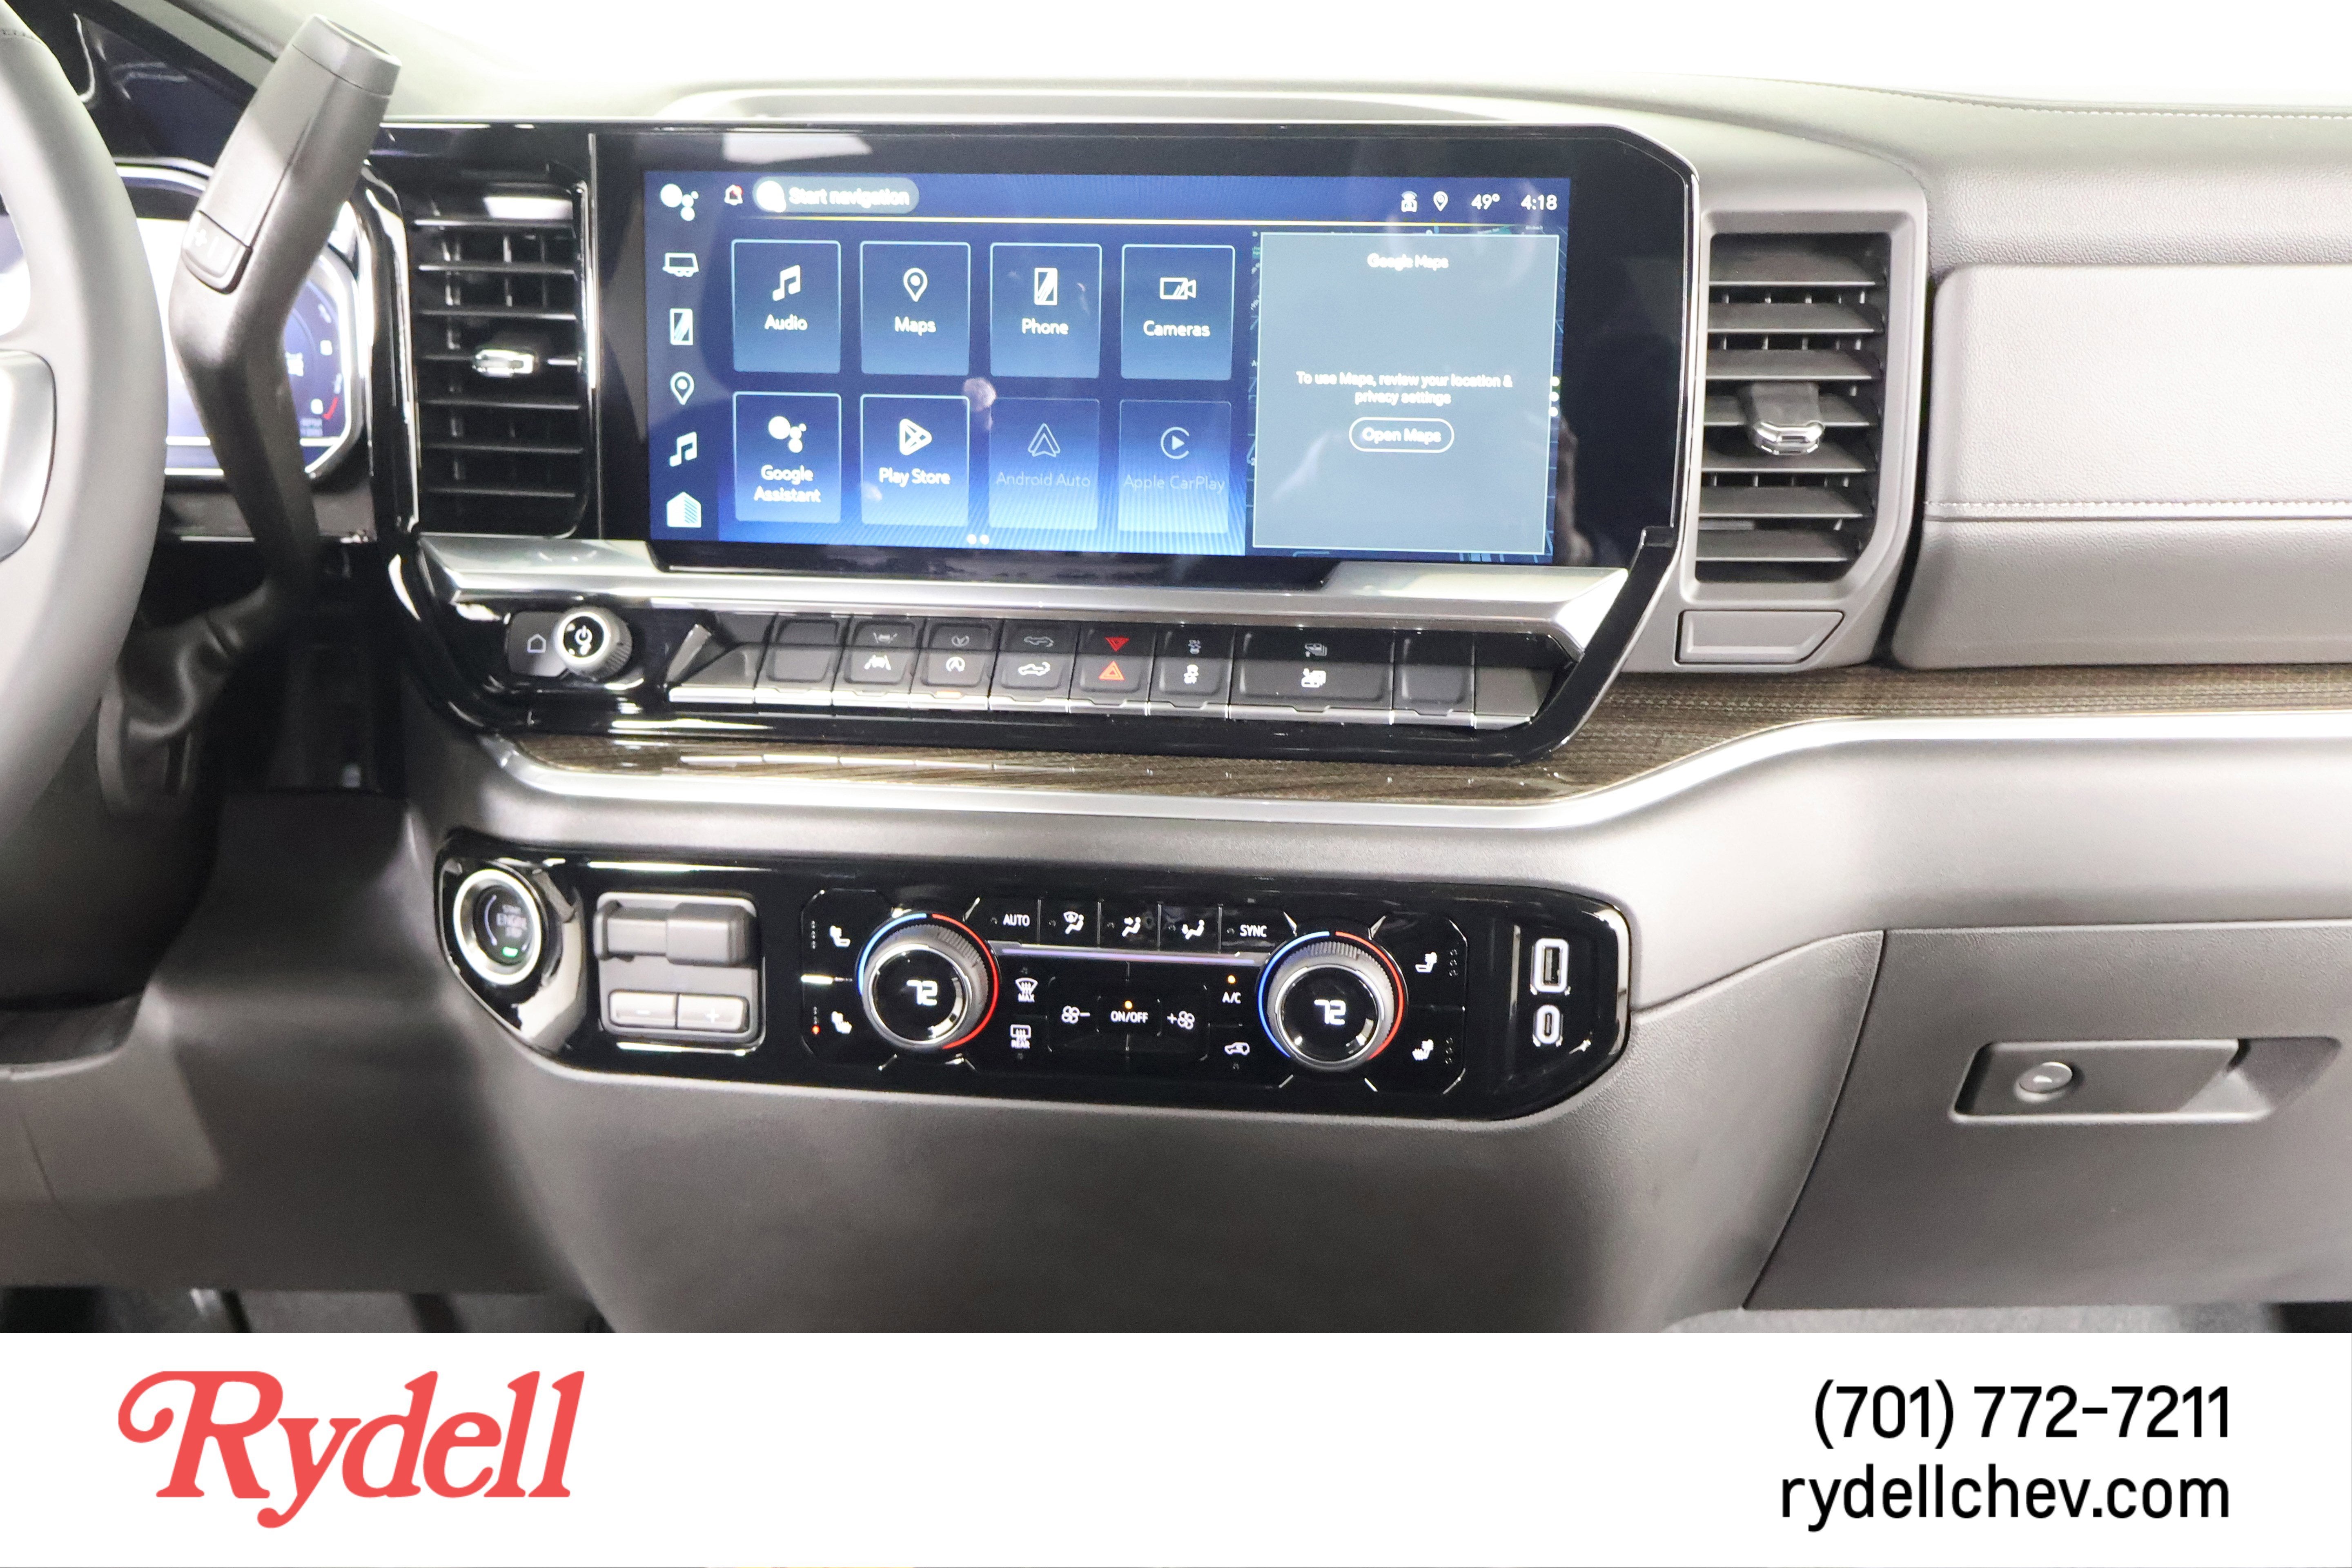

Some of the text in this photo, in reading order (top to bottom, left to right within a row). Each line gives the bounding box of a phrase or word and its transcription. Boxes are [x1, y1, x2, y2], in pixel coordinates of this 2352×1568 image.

[788, 187, 910, 209] Start navigation
[1521, 195, 1557, 210] 4:18
[1367, 253, 1449, 271] Google Maps
[765, 314, 808, 331] Audio
[895, 316, 936, 336] Maps
[1022, 318, 1069, 335] Phone
[1143, 321, 1211, 337] Cameras
[1296, 371, 1513, 389] To use Maps, review your location &
[1355, 390, 1452, 407] privacy settings
[1361, 427, 1441, 445] Open Maps
[761, 465, 813, 485] Google
[879, 468, 951, 487] Play Store
[996, 472, 1091, 488] Android Auto
[1123, 474, 1225, 494] Apple CarPlay
[754, 486, 821, 503] Assistant
[1003, 914, 1030, 927] AUTO
[1240, 924, 1267, 938] SYNC
[906, 980, 938, 1006] 72
[1018, 993, 1035, 1002] MAX
[1222, 992, 1241, 1004] A/C
[1111, 1011, 1148, 1023] ON/OFF
[1314, 999, 1346, 1025] 72
[1011, 1040, 1030, 1049] REAR
